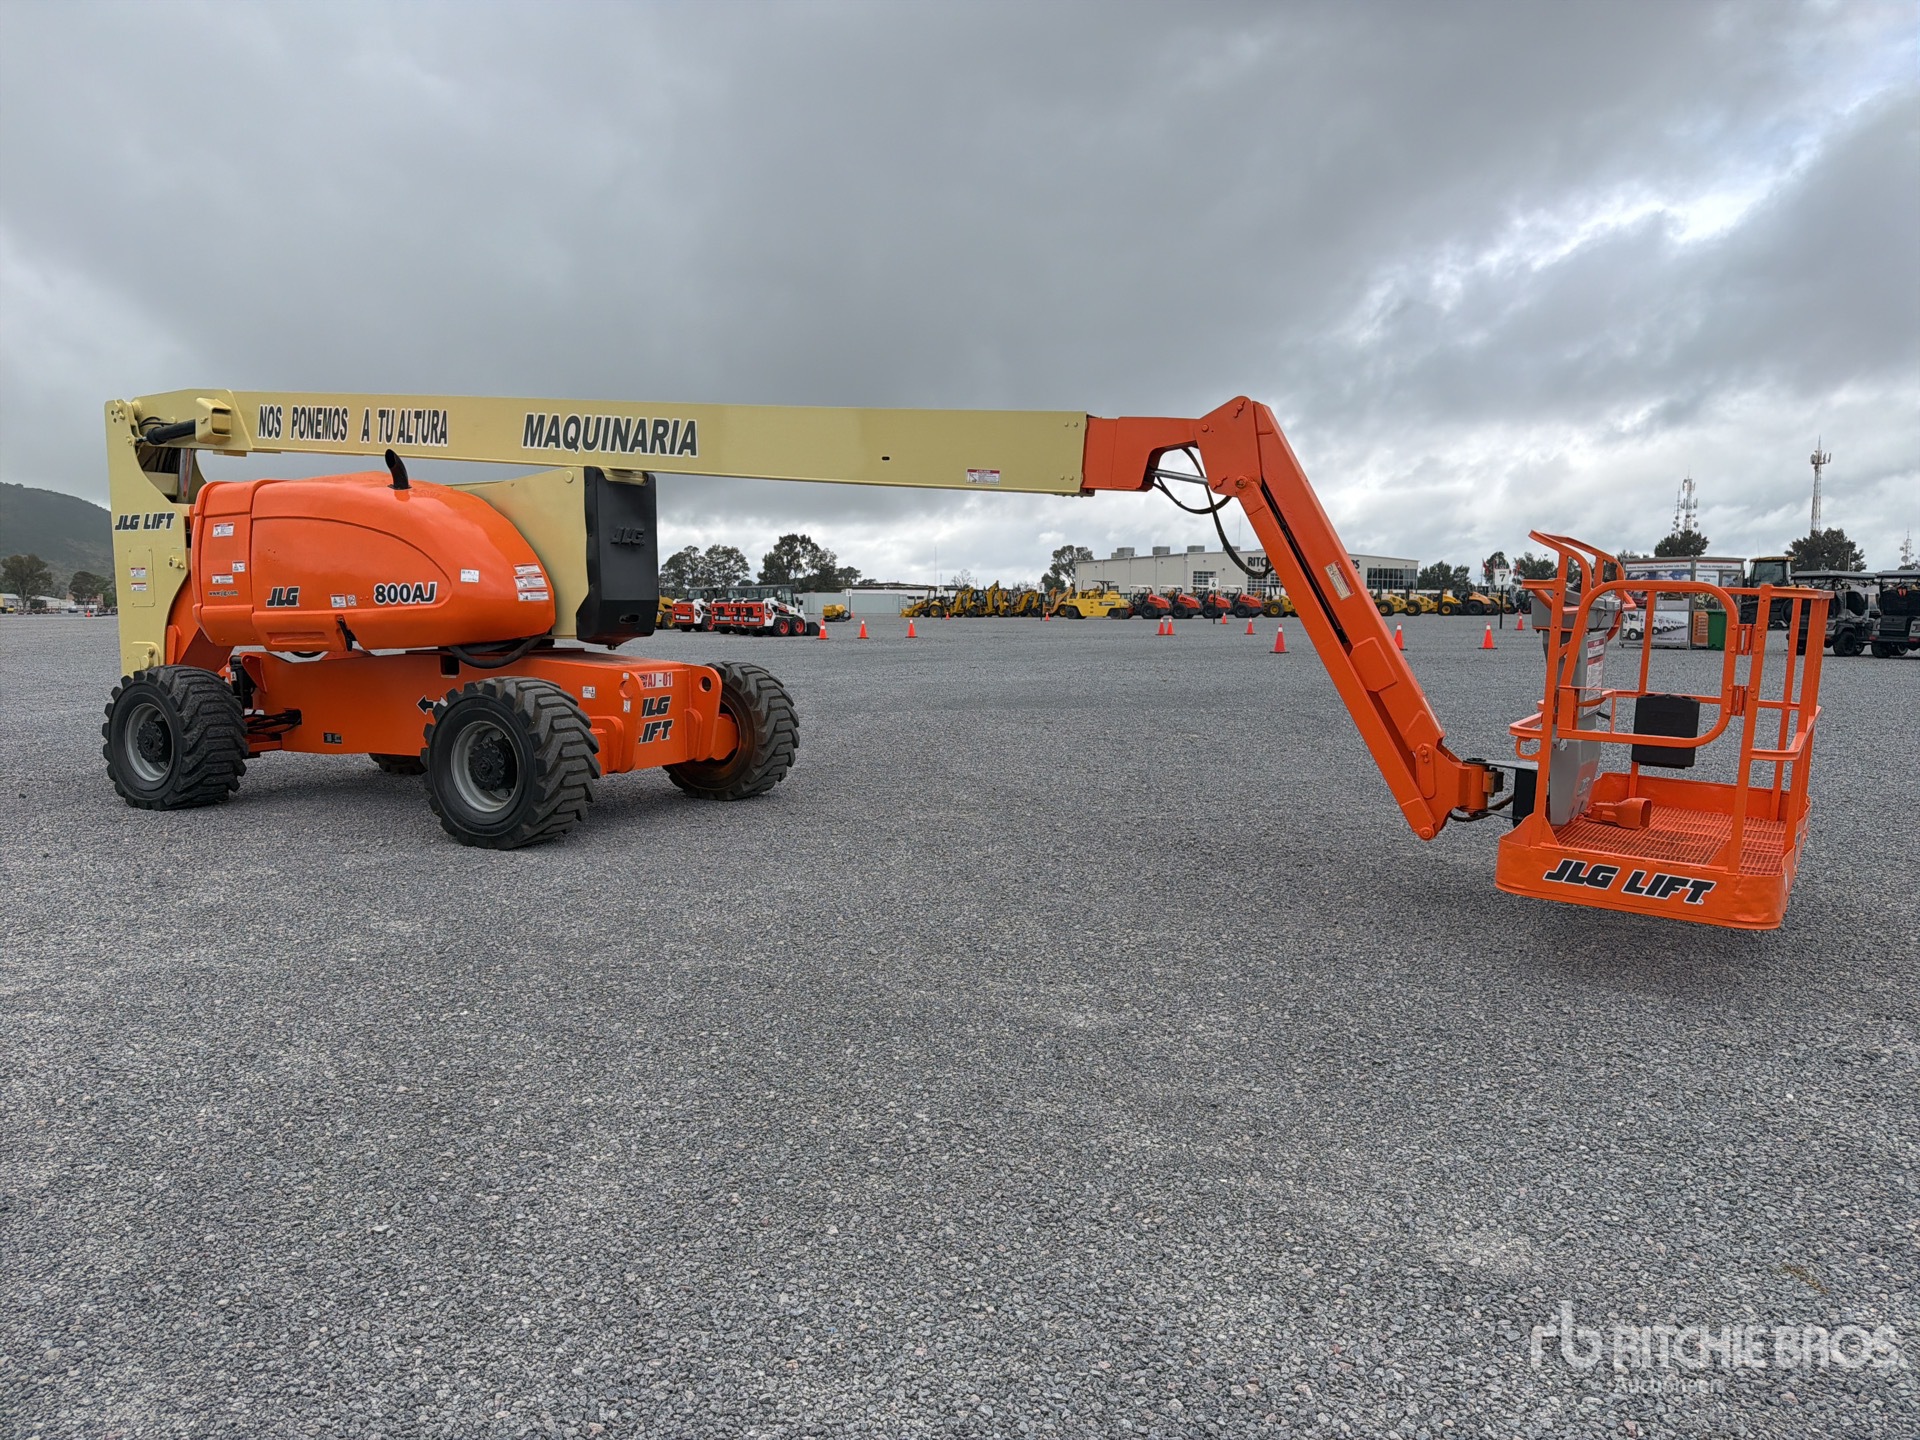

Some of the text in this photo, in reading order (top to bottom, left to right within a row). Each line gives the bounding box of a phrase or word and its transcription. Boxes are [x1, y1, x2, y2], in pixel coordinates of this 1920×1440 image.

[258, 405, 448, 445] NOS PONEMOS A TU ALTURA
[522, 413, 698, 457] MAQUINARIA
[114, 512, 175, 531] JLG LIFT
[611, 527, 645, 545] JLG
[1211, 580, 1217, 588] 6
[1500, 573, 1506, 582] 7
[267, 587, 299, 607] JLG
[374, 583, 437, 604] 800AJ
[638, 719, 674, 744] IFT
[1543, 858, 1717, 905] JLG LIFT
